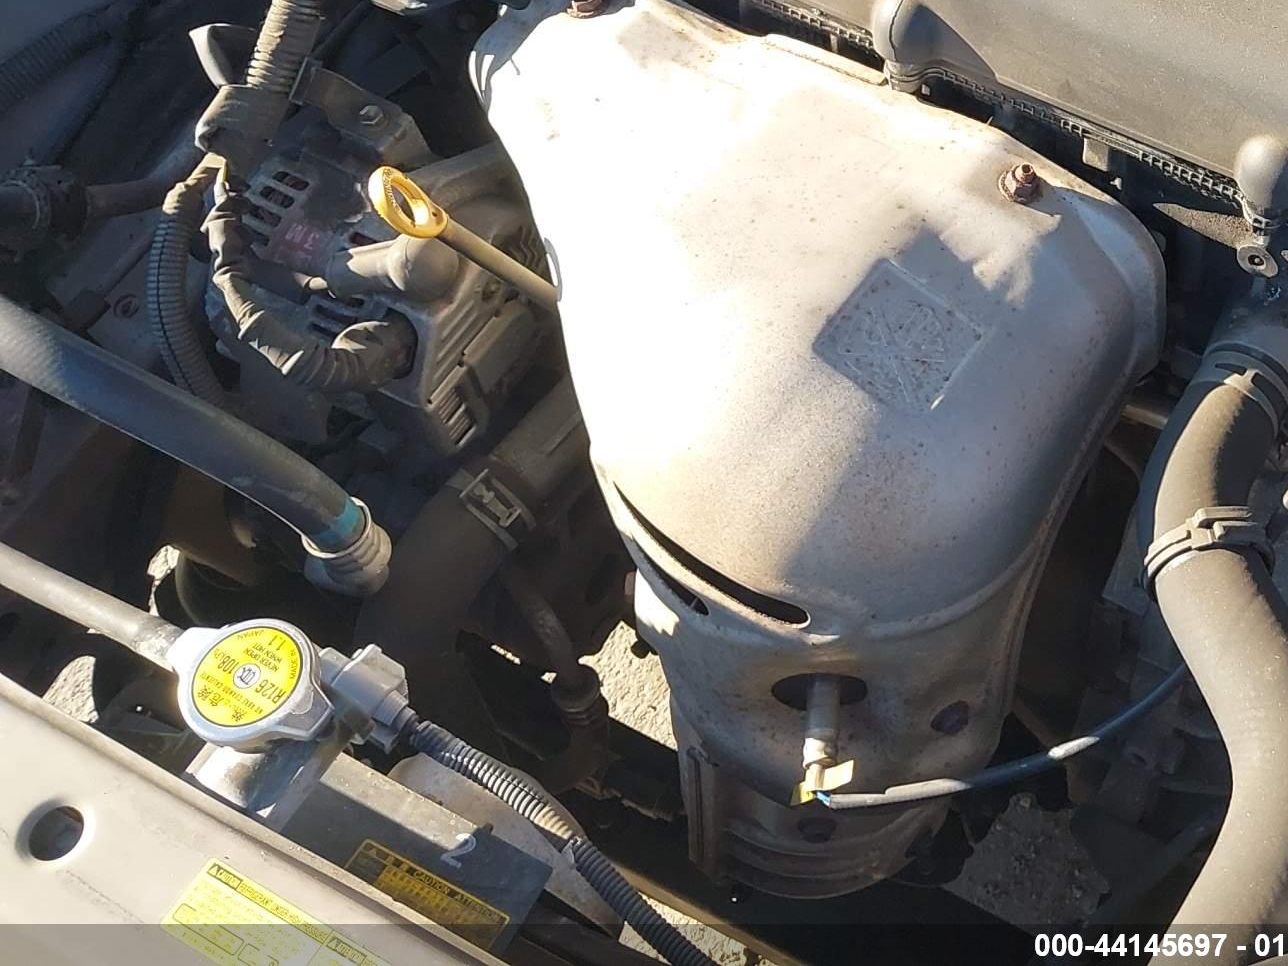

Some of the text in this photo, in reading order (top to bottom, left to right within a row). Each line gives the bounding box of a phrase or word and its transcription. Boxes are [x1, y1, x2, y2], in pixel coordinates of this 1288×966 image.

[218, 654, 240, 676] 108
[255, 678, 287, 705] R126
[441, 833, 477, 867] 2
